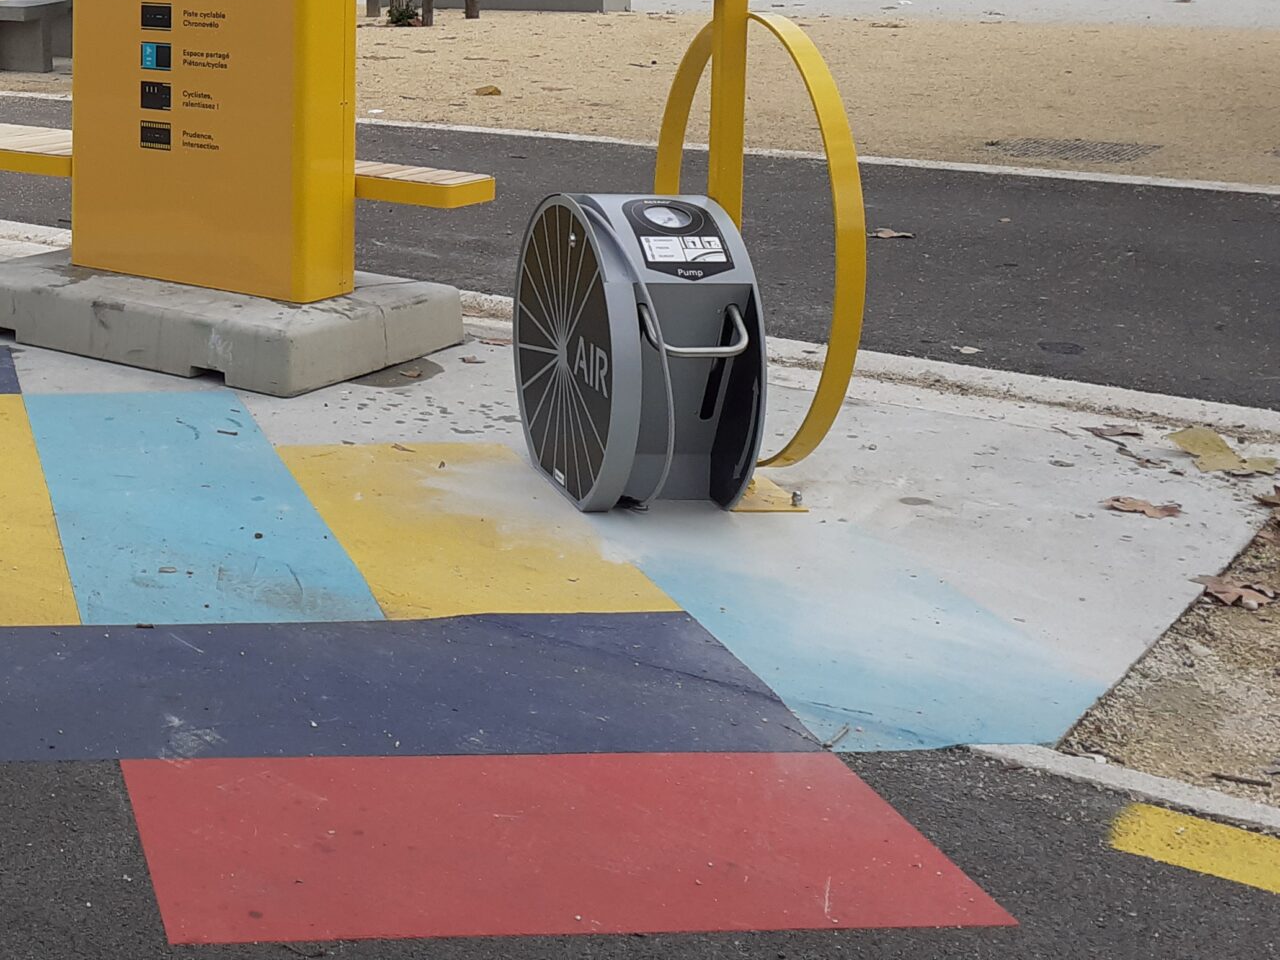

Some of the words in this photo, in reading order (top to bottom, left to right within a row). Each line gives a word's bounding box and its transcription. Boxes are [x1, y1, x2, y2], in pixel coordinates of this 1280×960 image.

[182, 10, 199, 18] Piste
[200, 11, 226, 19] cyclable
[182, 19, 220, 29] Chronovélo
[182, 49, 205, 58] Espace
[205, 52, 230, 60] partagé
[182, 100, 216, 110] ralentissez
[677, 268, 704, 278] Pump
[574, 335, 609, 399] AIR
